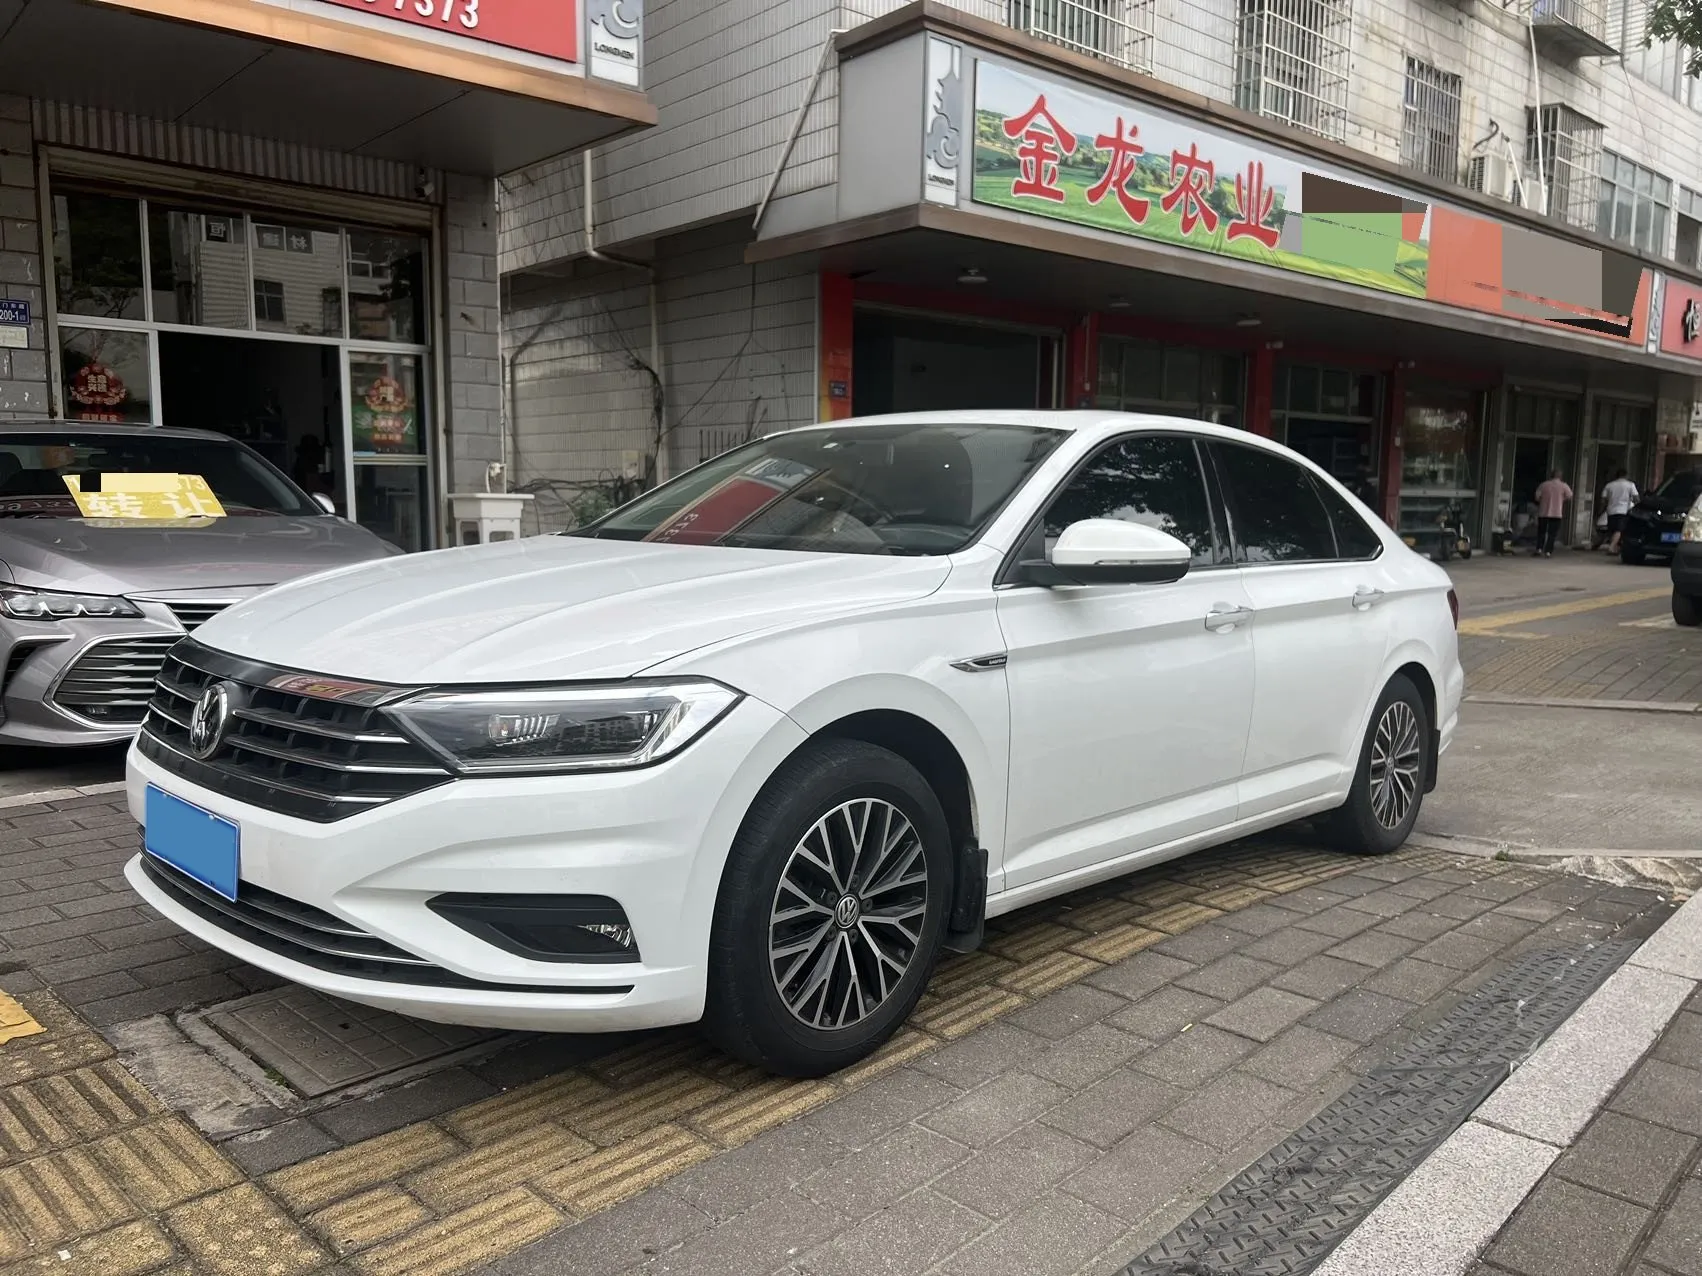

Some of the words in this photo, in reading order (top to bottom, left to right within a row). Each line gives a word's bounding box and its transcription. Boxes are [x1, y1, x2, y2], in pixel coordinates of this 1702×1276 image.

[1003, 94, 1281, 249] 金龙农业
[83, 492, 214, 519] 转让
